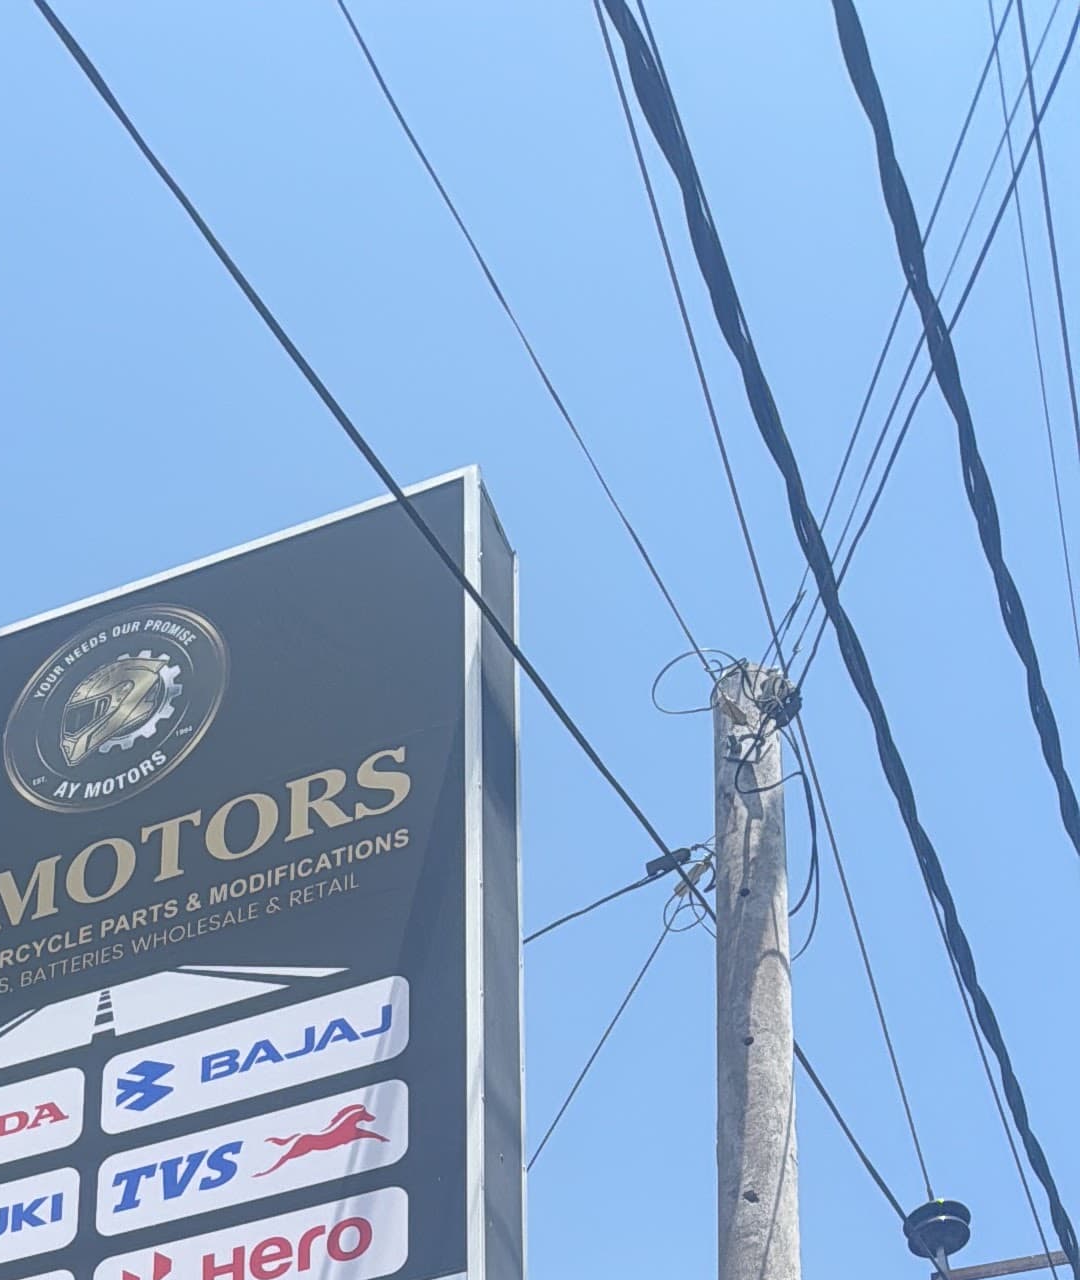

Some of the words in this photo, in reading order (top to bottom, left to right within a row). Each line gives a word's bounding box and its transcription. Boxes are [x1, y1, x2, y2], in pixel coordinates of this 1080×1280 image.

[34, 665, 65, 700] YOUR
[64, 631, 108, 665] NEEDS
[112, 621, 141, 638] OUR
[143, 619, 197, 647] PROMISE
[52, 780, 82, 799] AY
[83, 750, 168, 798] MOTORS
[100, 898, 179, 939] PARTS
[185, 892, 202, 913] &
[209, 827, 410, 906] MODIFICATIONS
[19, 943, 124, 990] BATTERIES
[131, 902, 261, 955] WHOLESALE
[265, 896, 282, 915] &
[289, 871, 360, 908] RETAIL
[199, 1004, 393, 1083] BAJAJ
[111, 1140, 243, 1213] TVS
